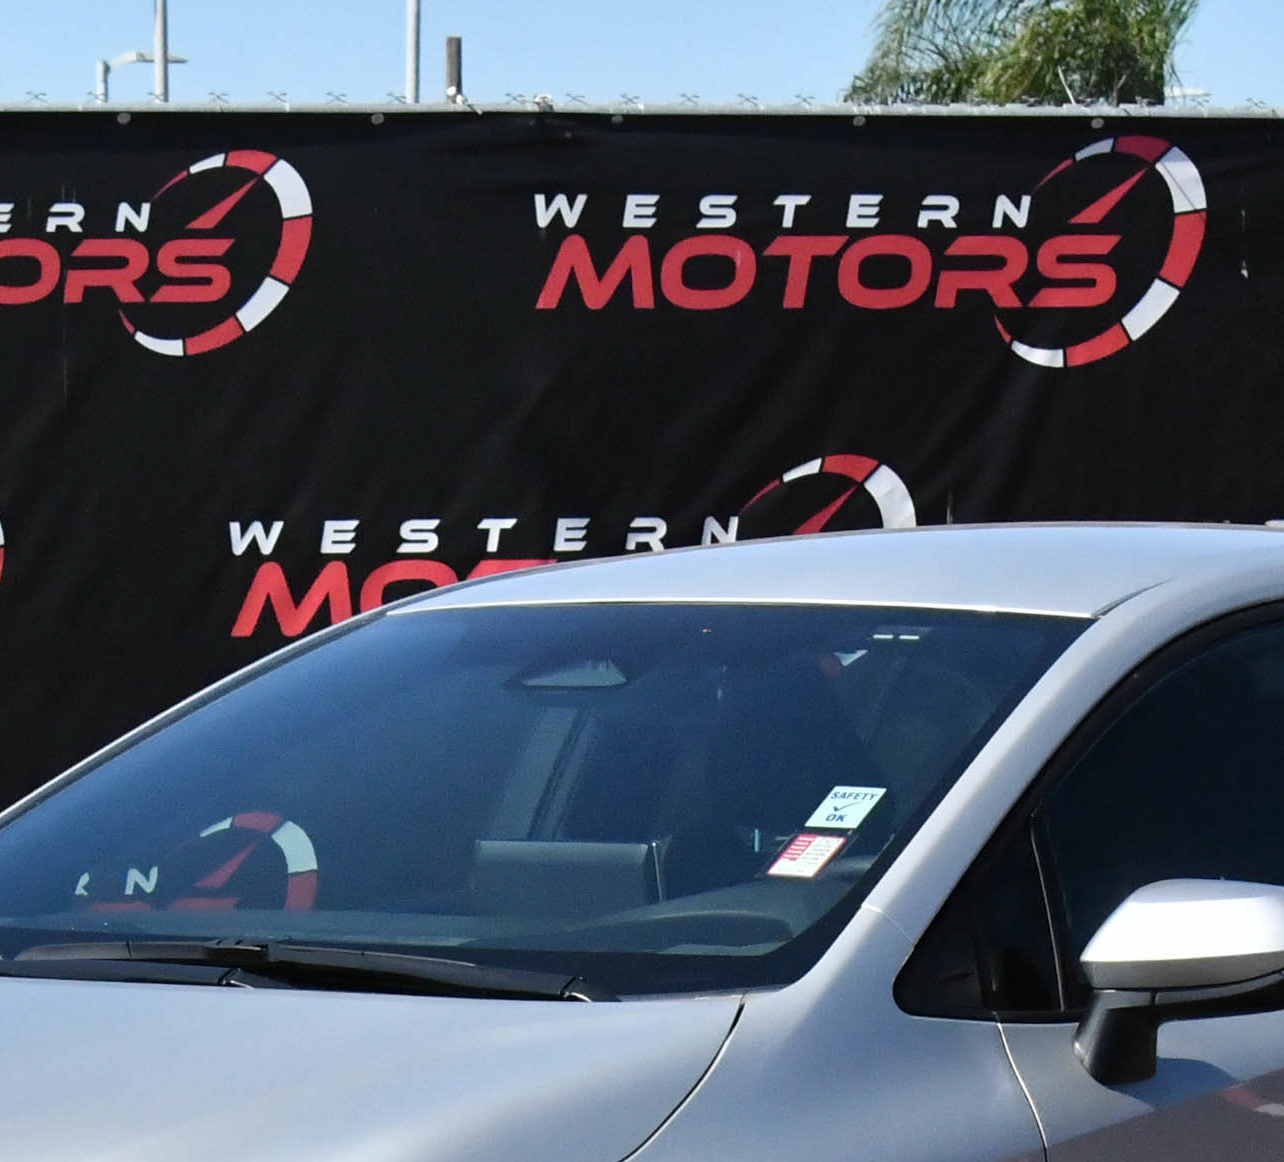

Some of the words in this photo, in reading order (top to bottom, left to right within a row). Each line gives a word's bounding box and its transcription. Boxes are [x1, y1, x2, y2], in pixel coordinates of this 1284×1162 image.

[535, 194, 1031, 228] WESTERN
[537, 235, 1120, 309] MOTORS
[229, 516, 739, 556] WESTERN
[829, 791, 877, 801] SAFETY
[825, 814, 847, 822] OK
